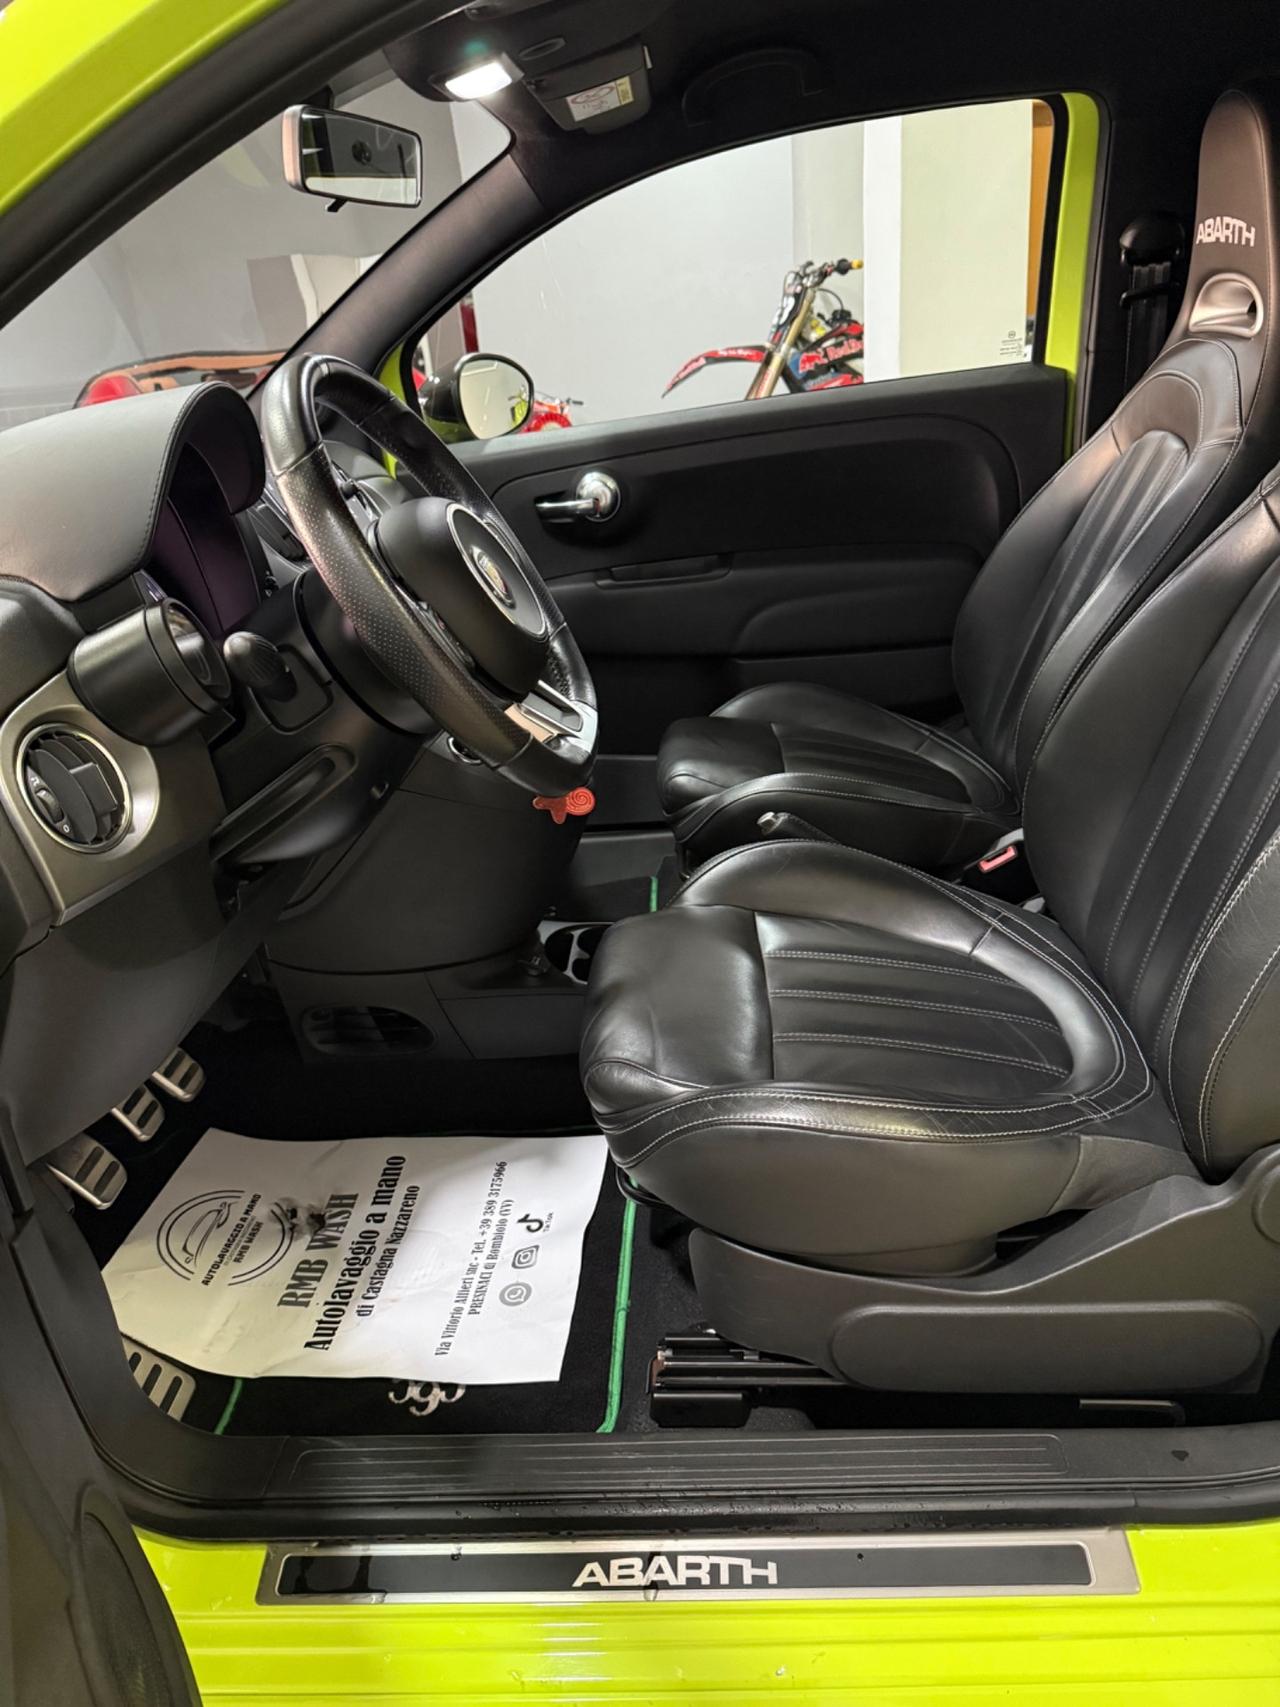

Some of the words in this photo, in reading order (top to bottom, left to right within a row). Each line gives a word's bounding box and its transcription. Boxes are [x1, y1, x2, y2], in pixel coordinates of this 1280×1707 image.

[1196, 215, 1255, 247] ABARTH
[371, 1155, 406, 1206] mano
[488, 1161, 508, 1198] 3175966
[365, 1212, 387, 1224] a
[384, 1185, 420, 1245] Nazzareno
[483, 1199, 498, 1216] 389
[479, 1218, 493, 1237] +39
[277, 1259, 328, 1308] RMB
[305, 1193, 359, 1251] WASH
[303, 1229, 380, 1351] Autolavaggio
[361, 1247, 398, 1300] Castagna
[356, 1304, 375, 1317] di
[441, 1306, 464, 1339] Vittorio
[435, 1341, 452, 1356] Via
[572, 1554, 778, 1588] ABARTH
